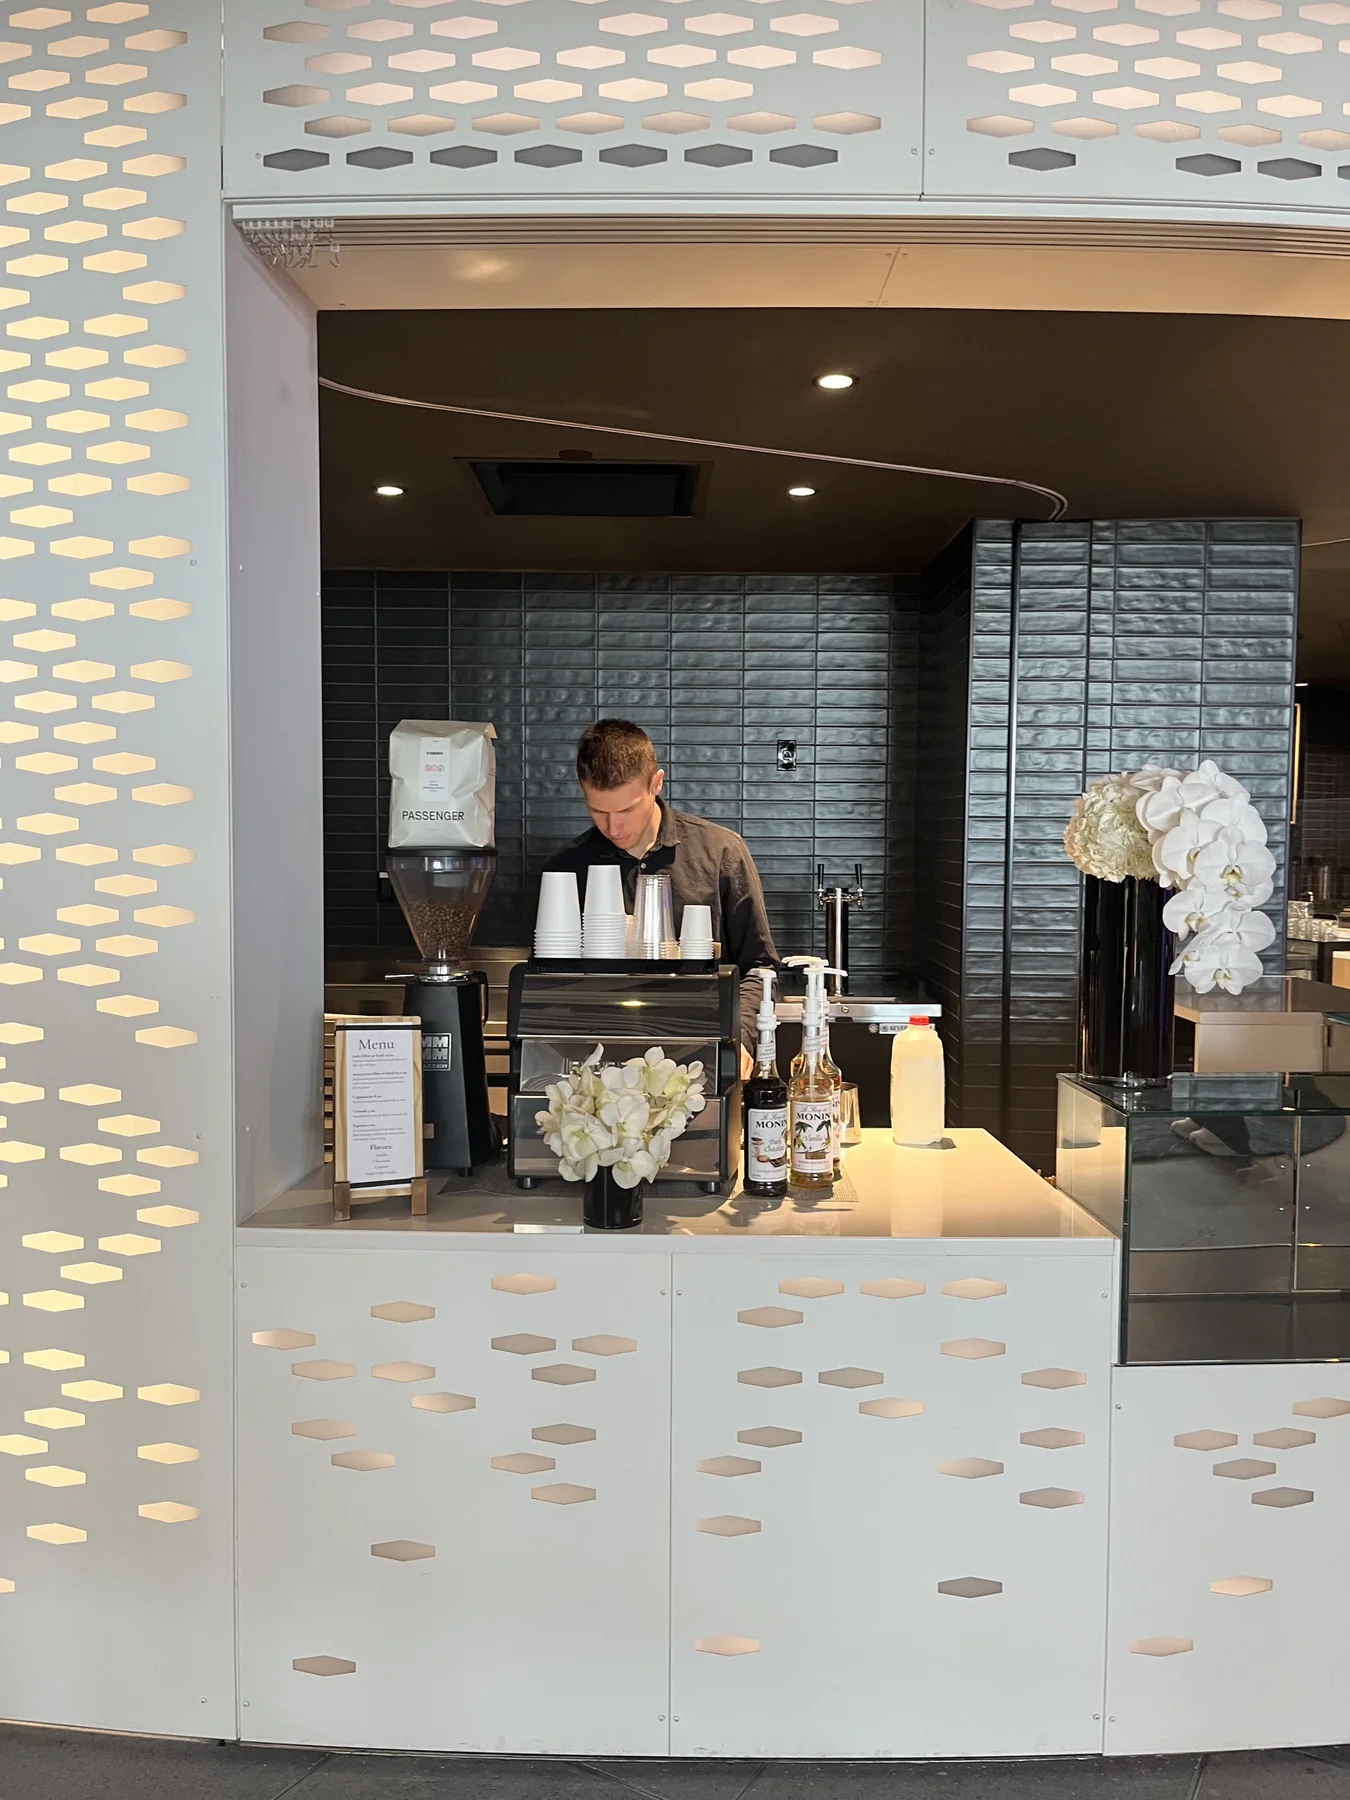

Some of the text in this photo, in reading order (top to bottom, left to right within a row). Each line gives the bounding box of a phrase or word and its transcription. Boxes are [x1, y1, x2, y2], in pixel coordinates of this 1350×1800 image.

[402, 810, 465, 821] PASSENGER
[358, 1038, 395, 1050] Menu
[796, 1112, 830, 1121] MONIN
